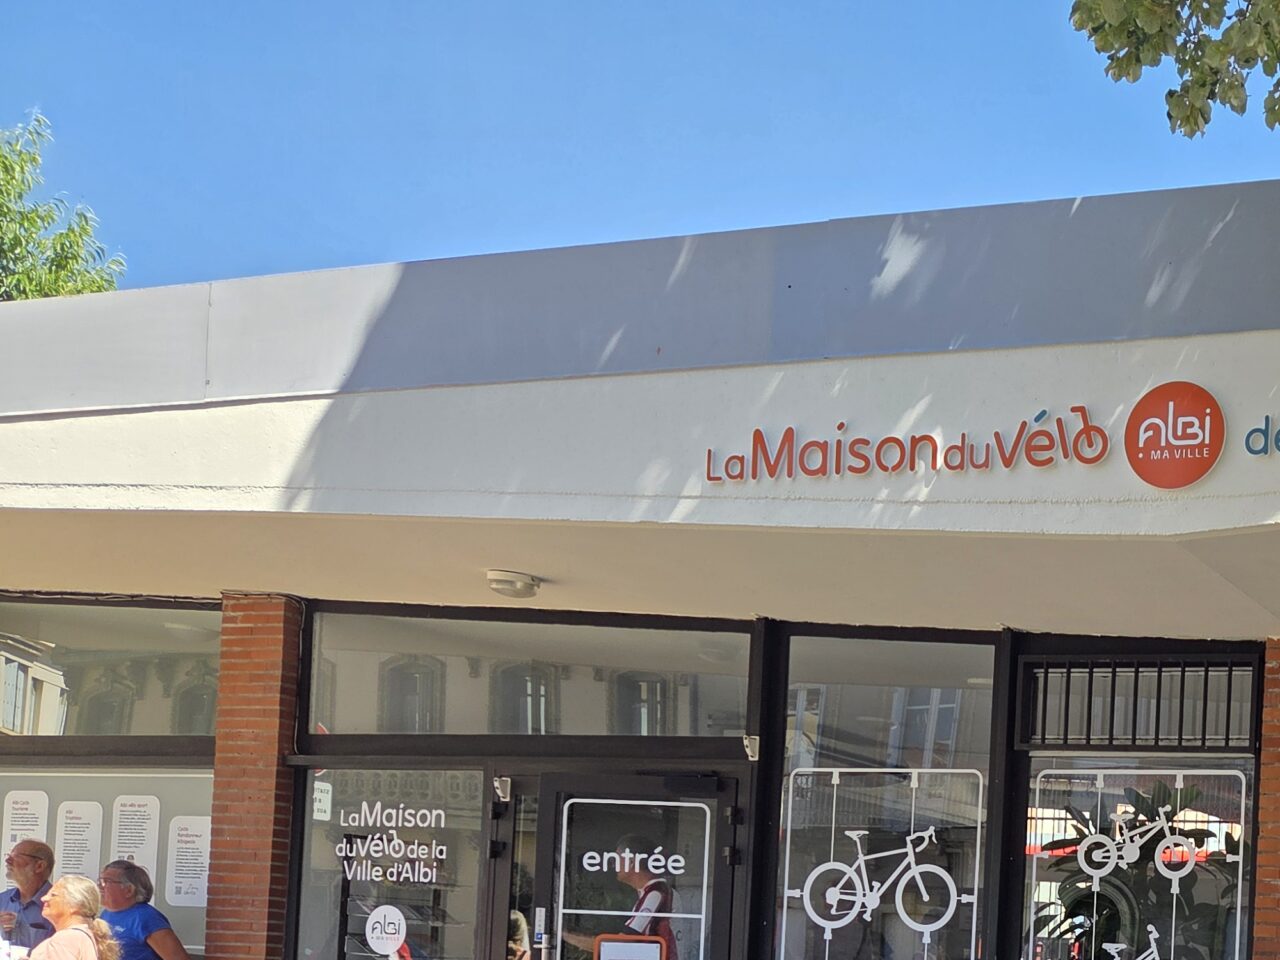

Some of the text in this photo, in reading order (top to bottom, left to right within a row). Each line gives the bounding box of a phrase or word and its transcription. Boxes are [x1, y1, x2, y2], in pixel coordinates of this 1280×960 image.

[1150, 447, 1210, 460] MA VILLE
[407, 839, 428, 858] de
[432, 840, 447, 859] la
[582, 846, 686, 875] entrée
[344, 860, 437, 883] Ville d'Albi
